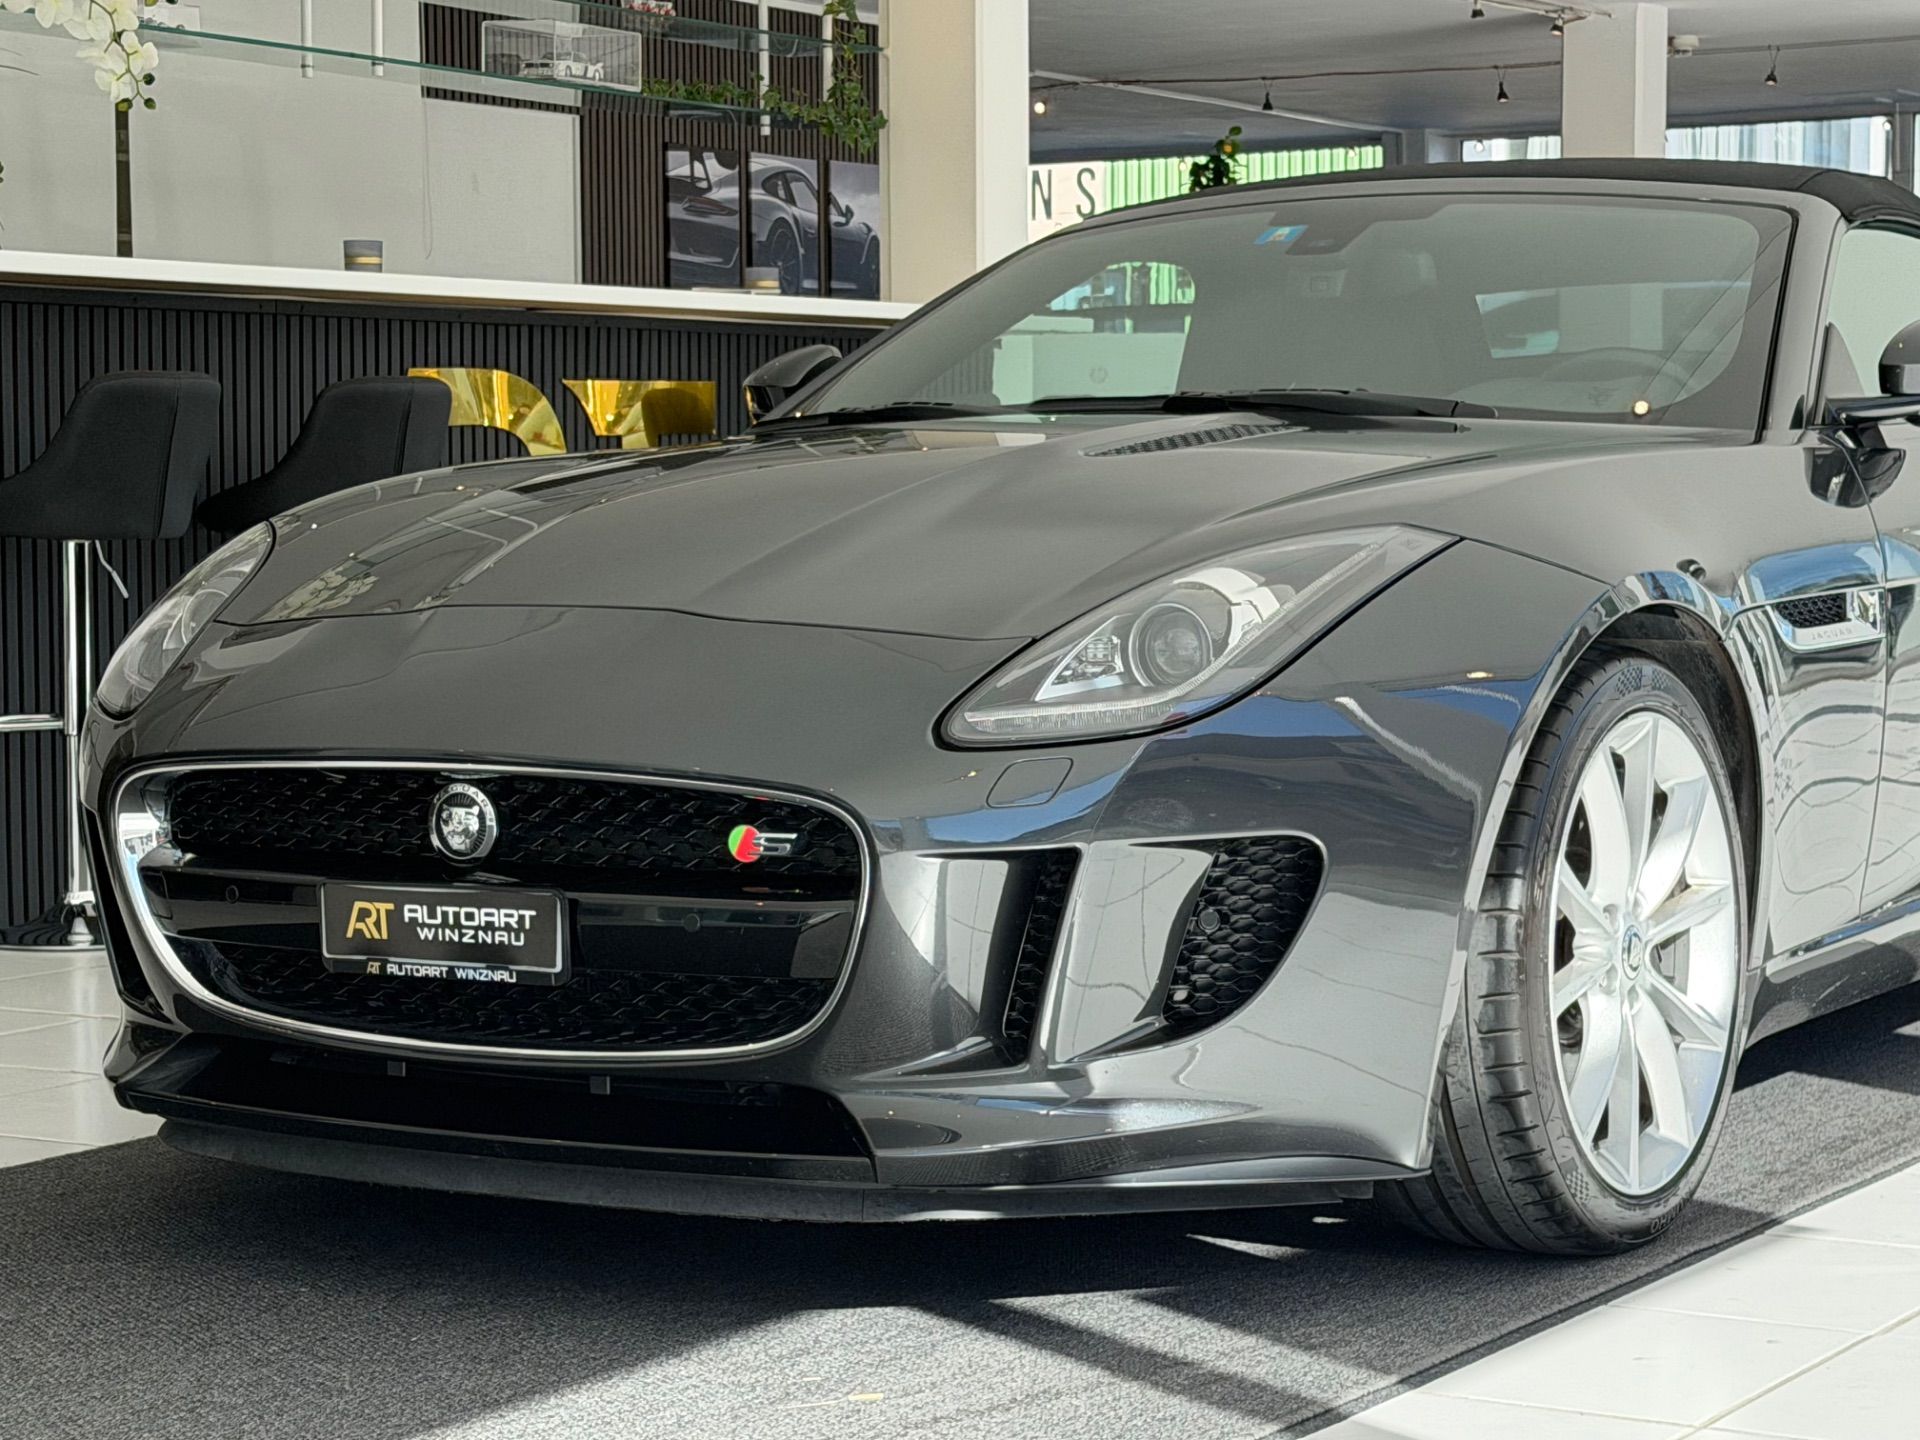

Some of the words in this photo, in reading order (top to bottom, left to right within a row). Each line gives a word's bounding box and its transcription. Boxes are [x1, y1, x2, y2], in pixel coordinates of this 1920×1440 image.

[403, 904, 537, 931] AUTOART
[416, 926, 525, 946] WINZNAU
[386, 963, 449, 978] AUTOART
[454, 967, 517, 983] WINZNAU
